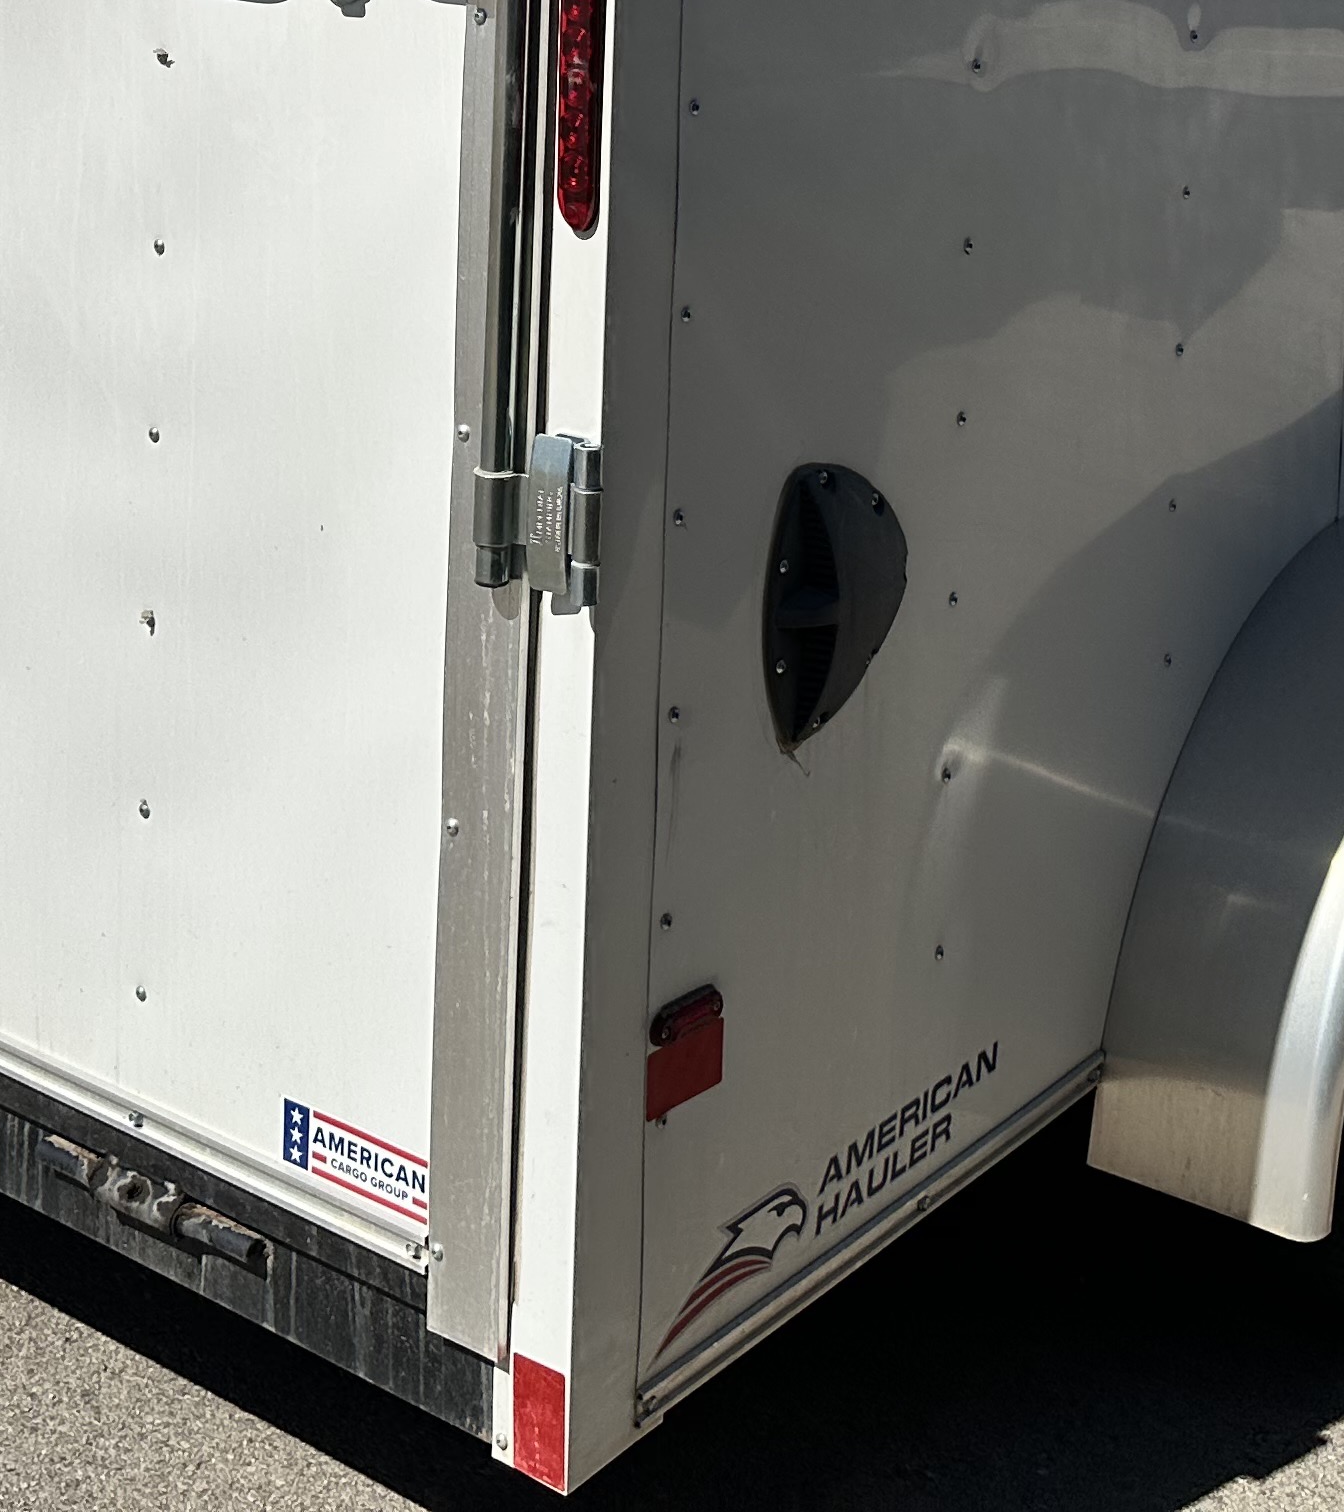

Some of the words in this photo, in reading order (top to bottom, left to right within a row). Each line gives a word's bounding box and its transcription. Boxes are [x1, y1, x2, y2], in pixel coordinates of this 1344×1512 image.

[312, 1126, 426, 1194] AMERICAN
[816, 1041, 999, 1196] AMERICAN
[330, 1158, 368, 1183] CARGO
[371, 1176, 409, 1201] GROUP
[815, 1113, 952, 1236] HAULER
